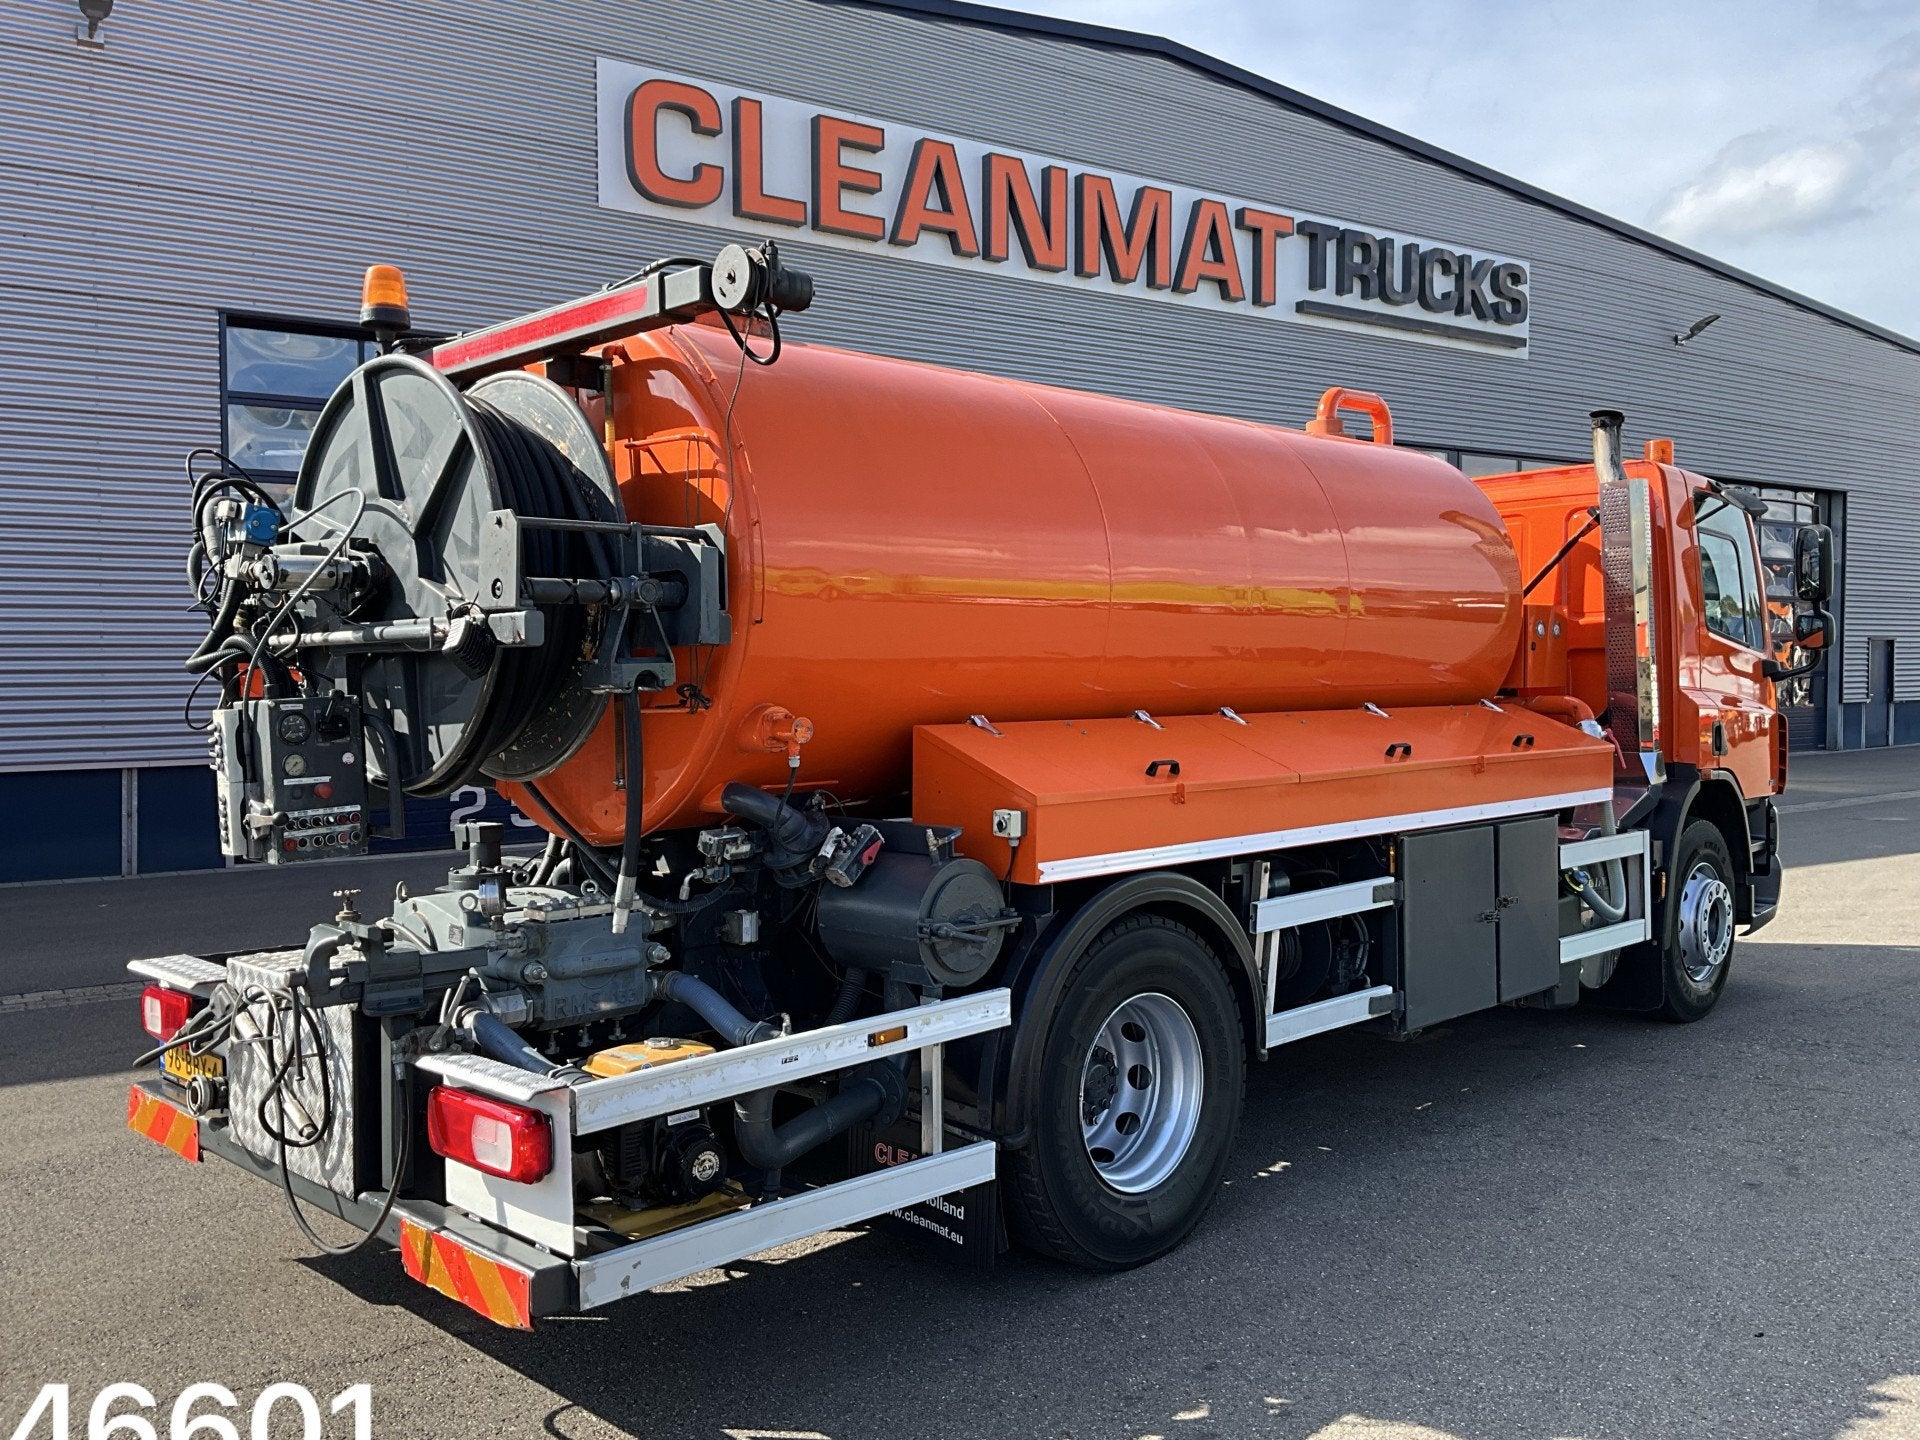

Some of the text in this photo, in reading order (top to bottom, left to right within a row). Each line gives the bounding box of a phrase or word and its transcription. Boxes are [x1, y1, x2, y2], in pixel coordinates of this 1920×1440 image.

[624, 79, 1528, 326] CLEANMAT TRUCKS
[887, 1208, 963, 1245] w.cleanmat.eu
